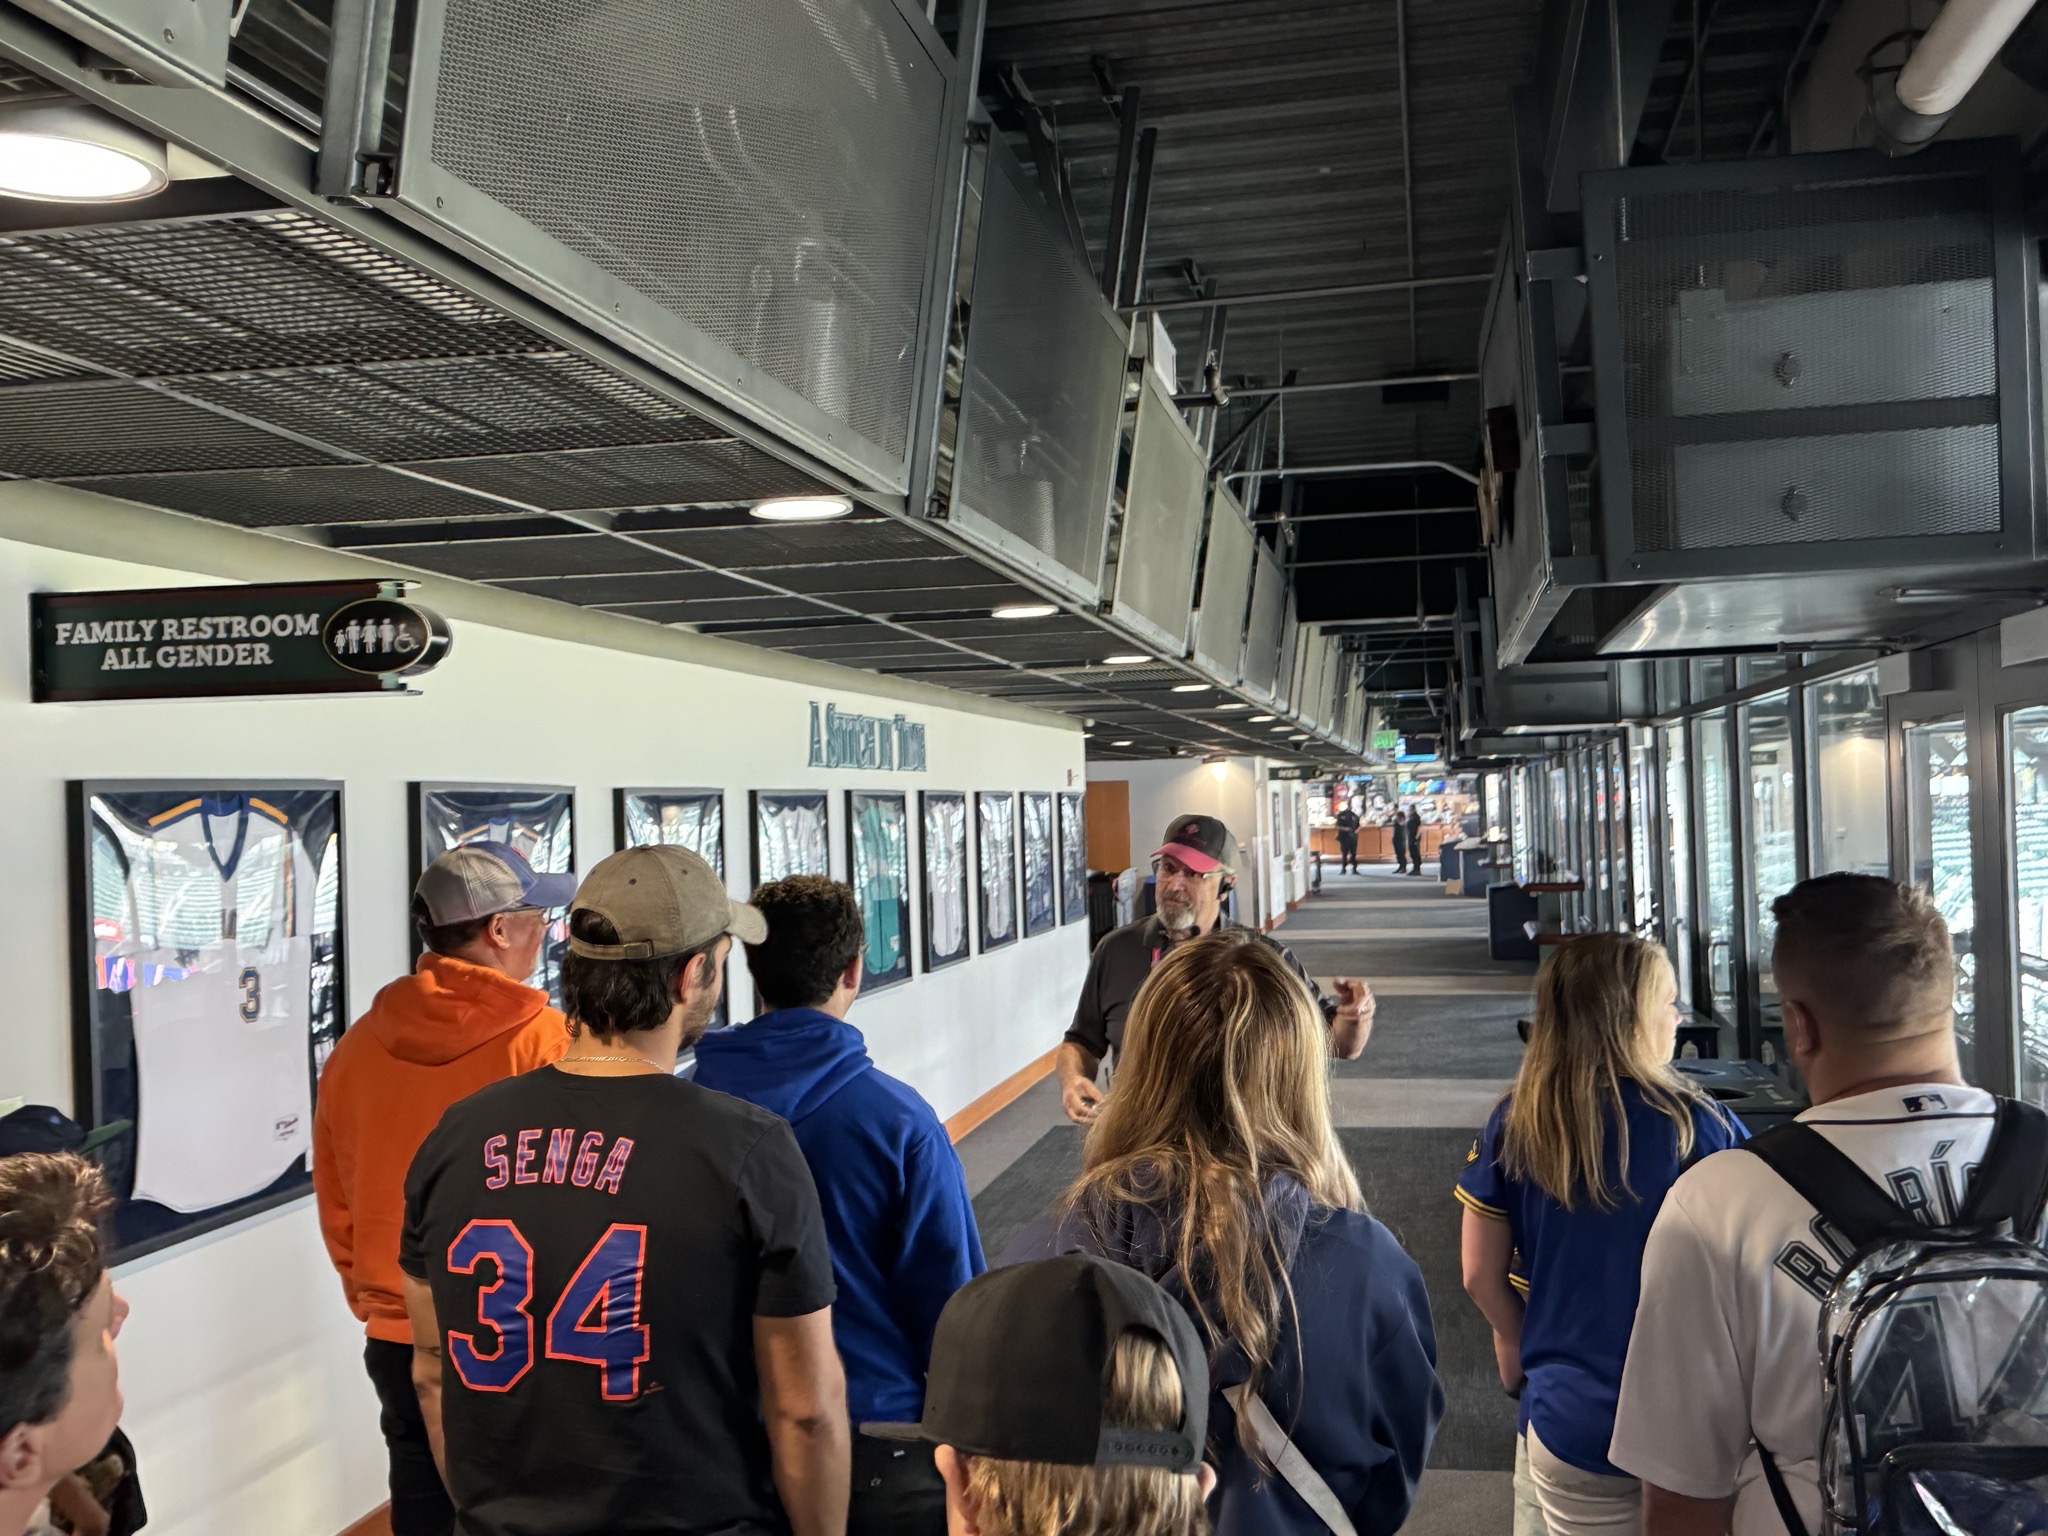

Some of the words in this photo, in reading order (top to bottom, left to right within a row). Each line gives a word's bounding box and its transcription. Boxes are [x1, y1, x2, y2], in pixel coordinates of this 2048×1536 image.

[55, 619, 158, 645] FAMILY
[161, 613, 320, 641] RESTROOM
[100, 647, 153, 670] ALL
[156, 643, 274, 668] GENDER
[238, 966, 262, 1023] 3
[483, 1128, 635, 1195] SENGA
[447, 1218, 651, 1401] 34
